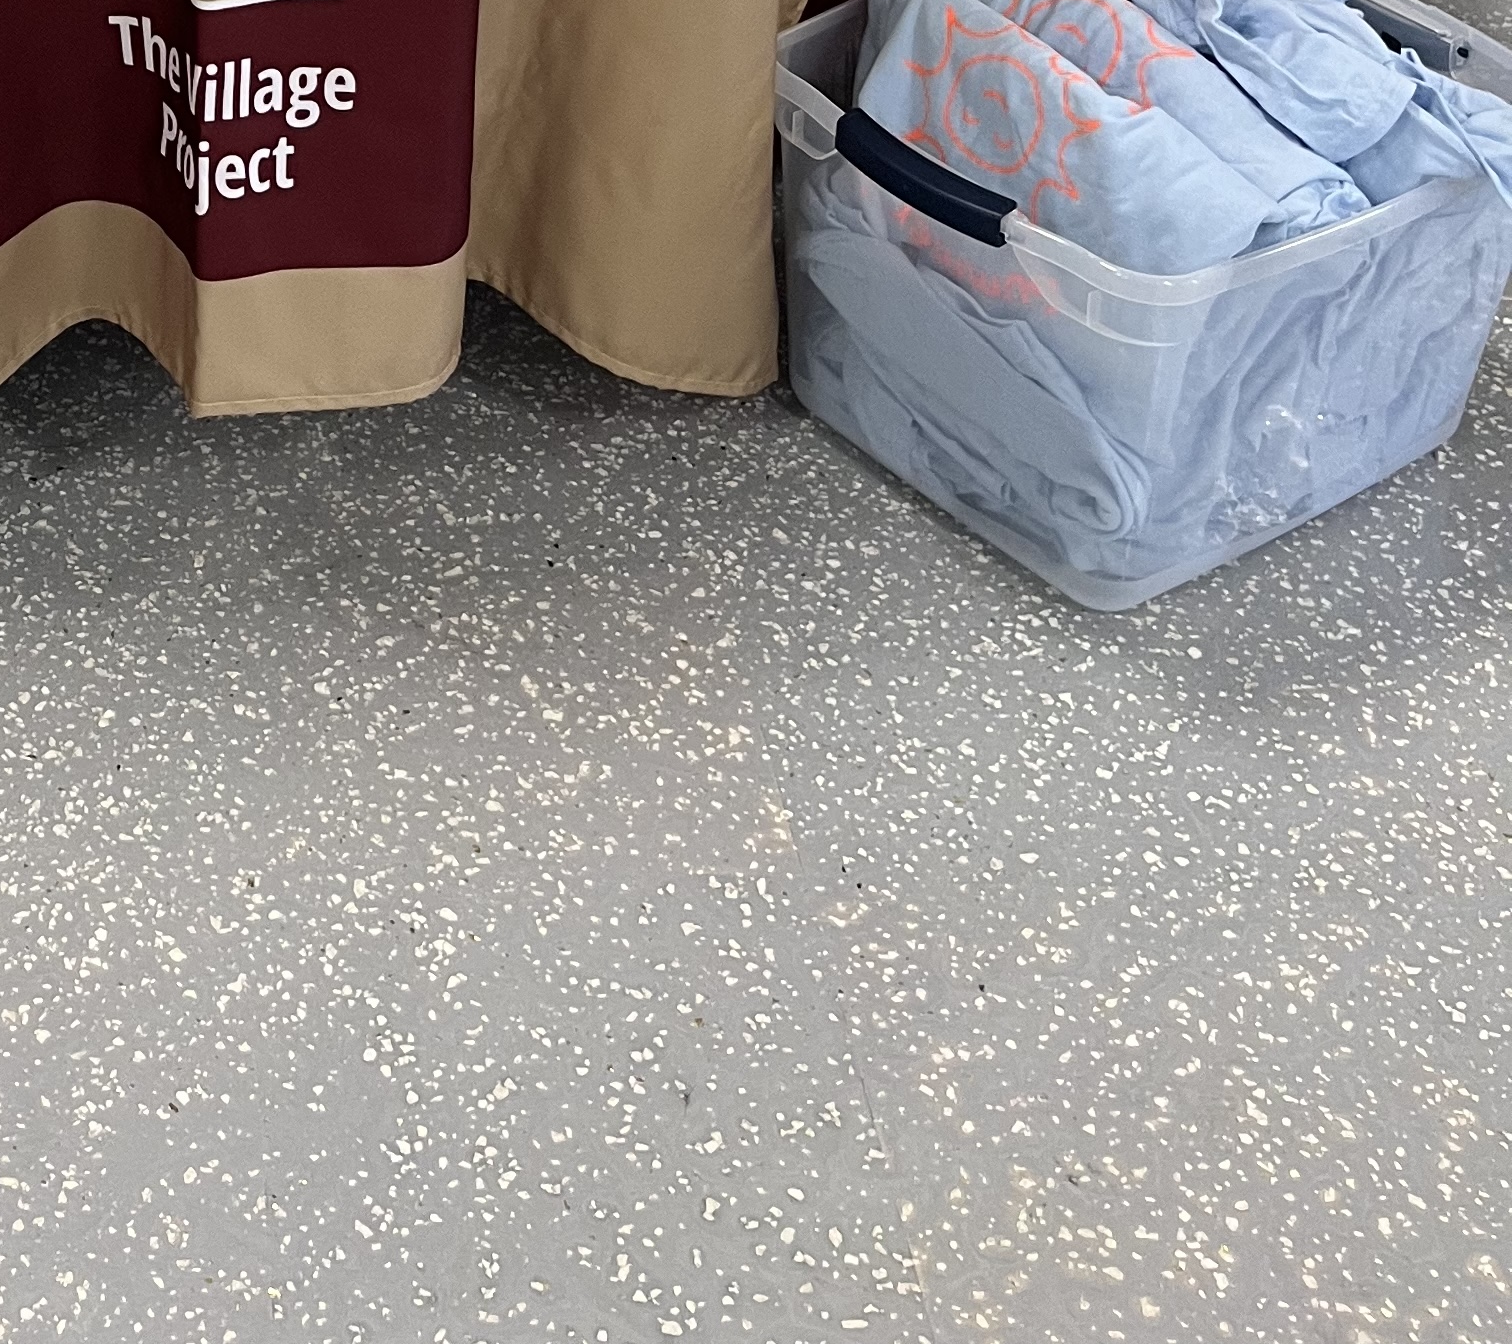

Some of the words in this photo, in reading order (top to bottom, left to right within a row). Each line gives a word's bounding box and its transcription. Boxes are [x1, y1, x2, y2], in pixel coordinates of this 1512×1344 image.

[108, 15, 180, 93] The
[185, 53, 356, 128] Village
[161, 102, 295, 215] Project
